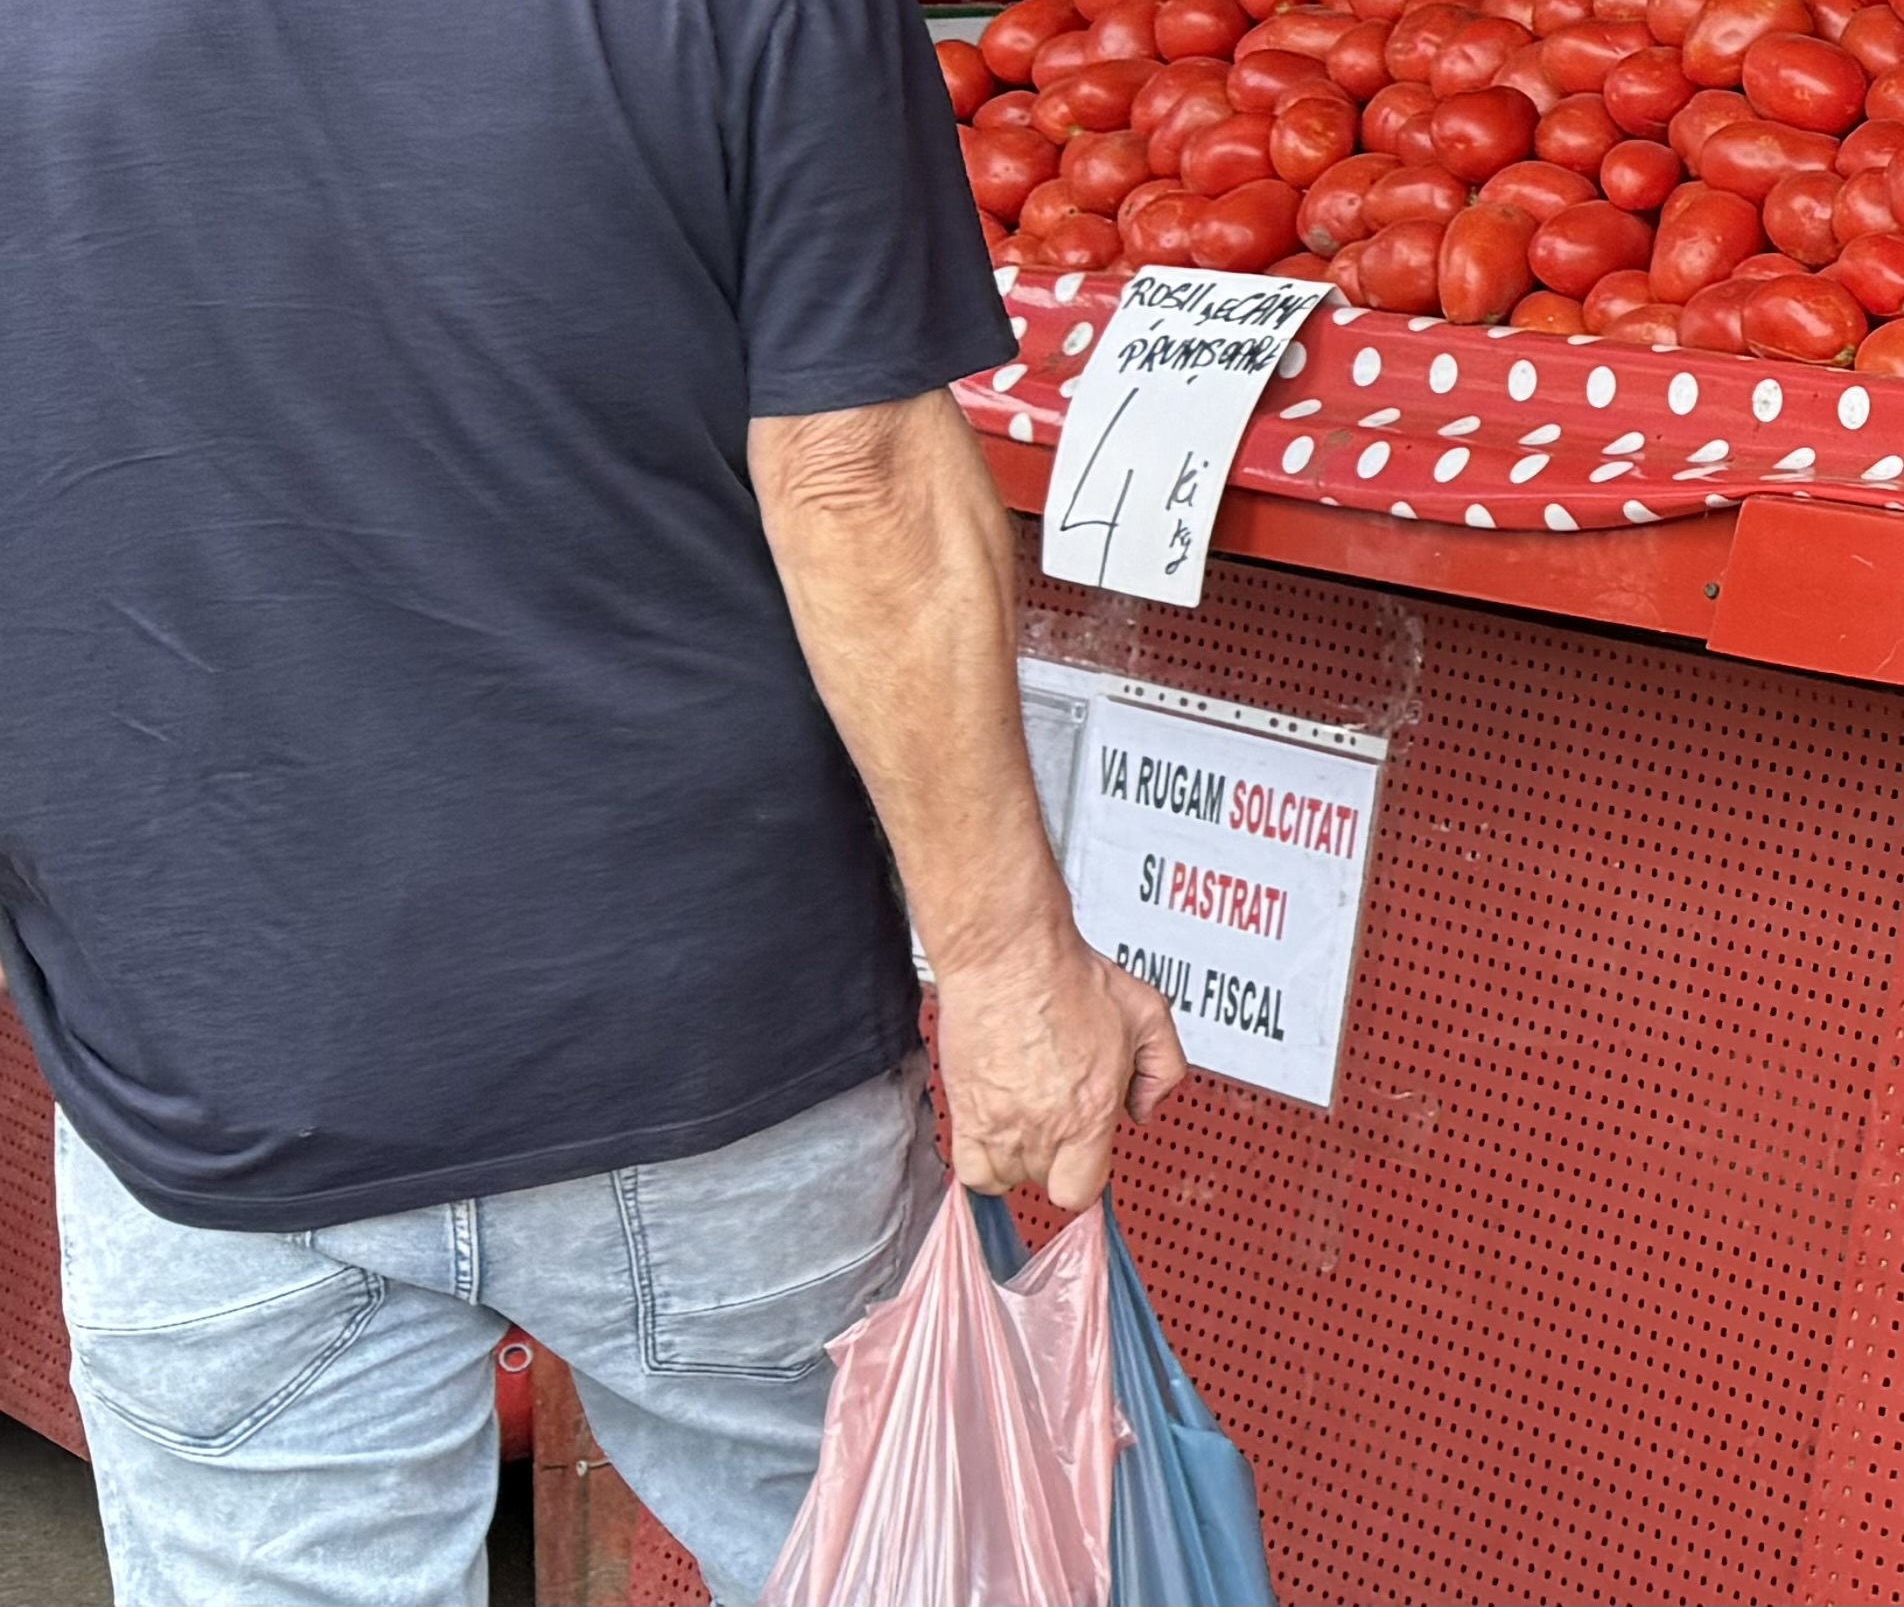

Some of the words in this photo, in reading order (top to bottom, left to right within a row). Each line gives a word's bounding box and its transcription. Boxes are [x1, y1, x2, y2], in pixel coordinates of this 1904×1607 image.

[1060, 387, 1139, 588] 4
[1165, 450, 1209, 511] lei
[1164, 518, 1194, 575] kg
[1100, 745, 1129, 799] VA
[1135, 755, 1226, 825] RUGAM
[1229, 778, 1360, 860] SOLCITATI
[1139, 852, 1164, 906] SI
[1168, 860, 1288, 941] PASTRATI
[1199, 968, 1286, 1042] FISCAL
